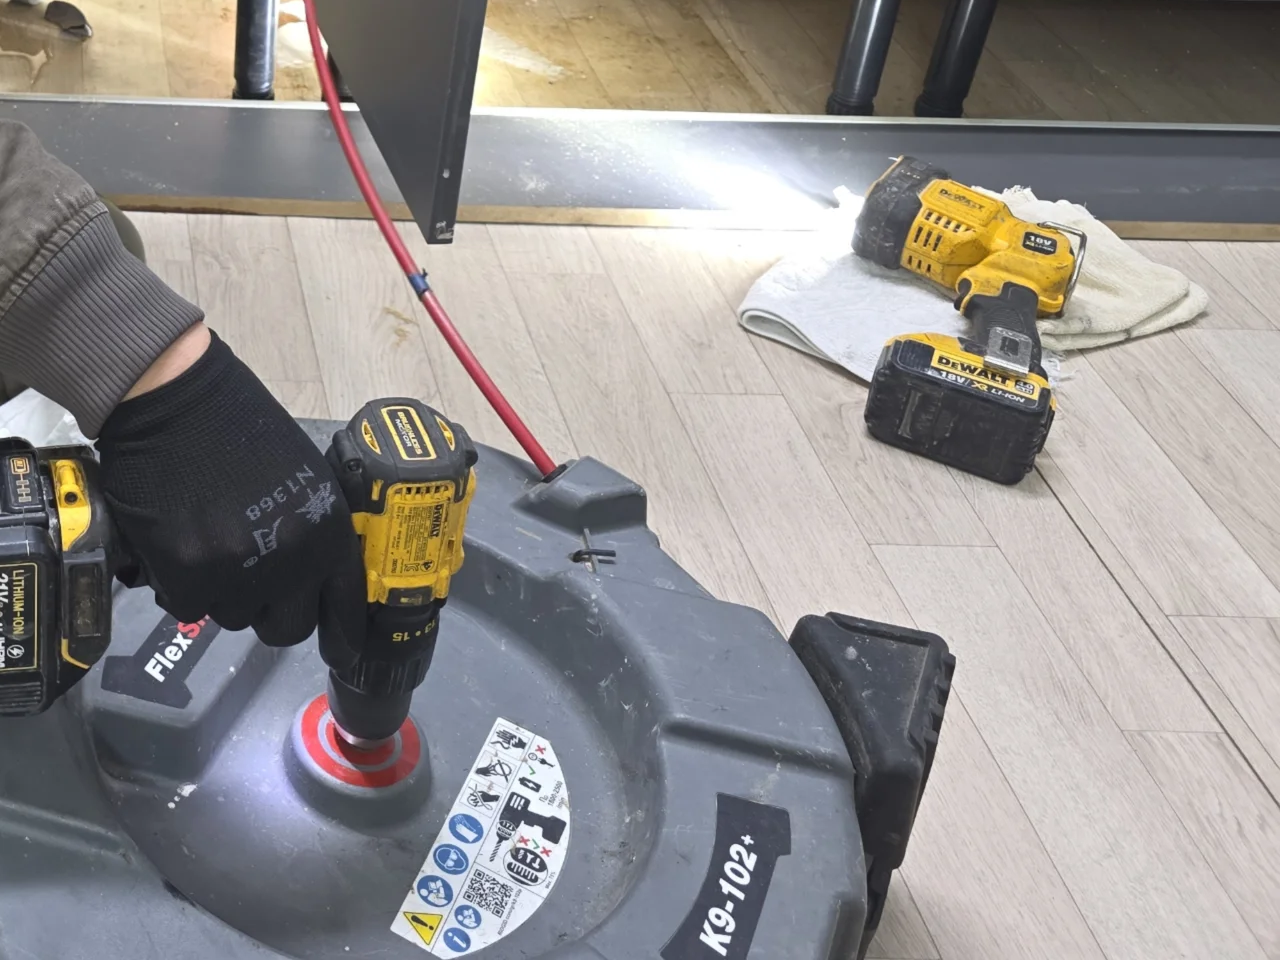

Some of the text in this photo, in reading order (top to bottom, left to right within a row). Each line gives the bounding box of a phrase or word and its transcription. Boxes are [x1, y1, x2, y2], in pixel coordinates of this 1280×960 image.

[245, 464, 315, 521] N1368
[13, 569, 24, 635] LITHIUM-ION
[144, 614, 210, 683] FlexS
[392, 631, 410, 642] 15
[699, 834, 758, 957] K9-102+
